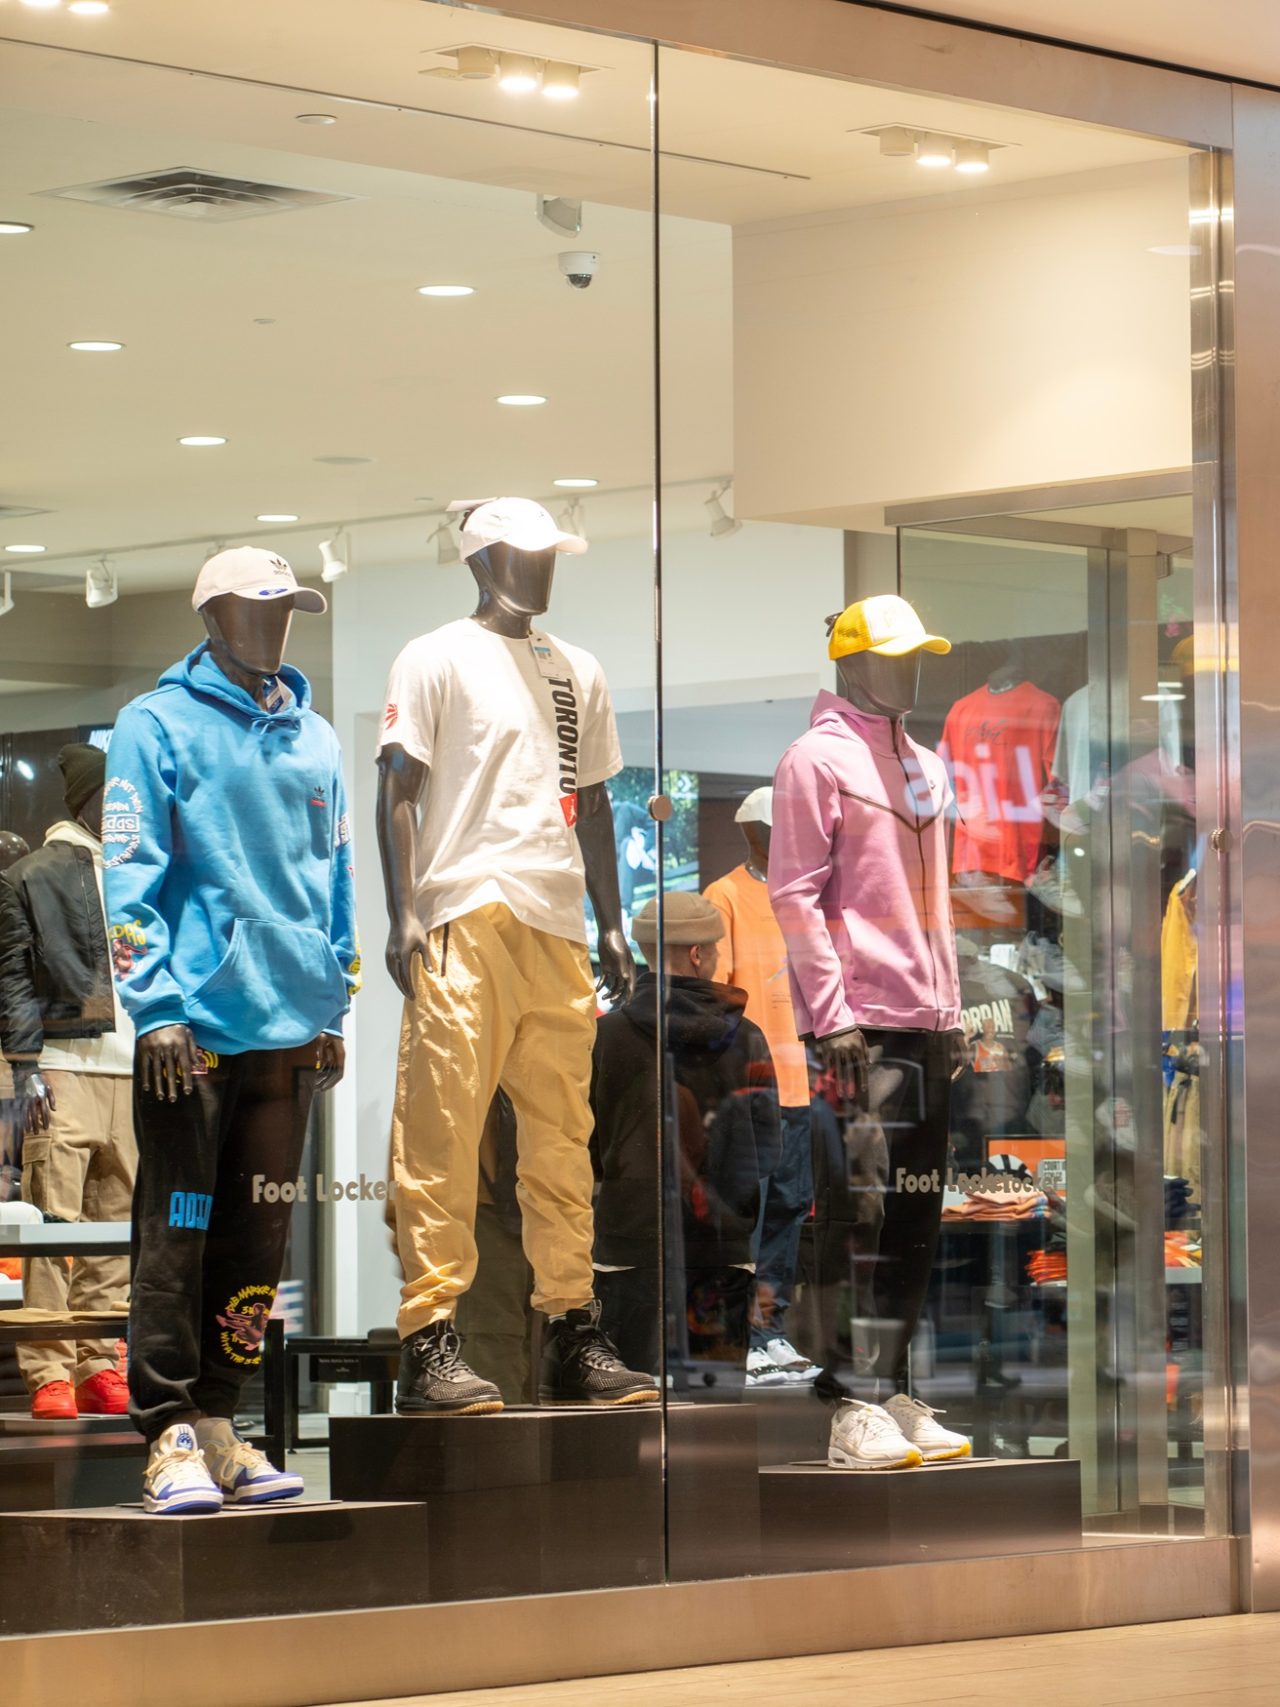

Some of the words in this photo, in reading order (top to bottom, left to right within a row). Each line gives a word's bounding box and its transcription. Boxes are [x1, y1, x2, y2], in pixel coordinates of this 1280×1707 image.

[252, 1174, 308, 1204] Foot
[316, 1173, 399, 1202] Locker
[895, 1167, 941, 1194] Foot
